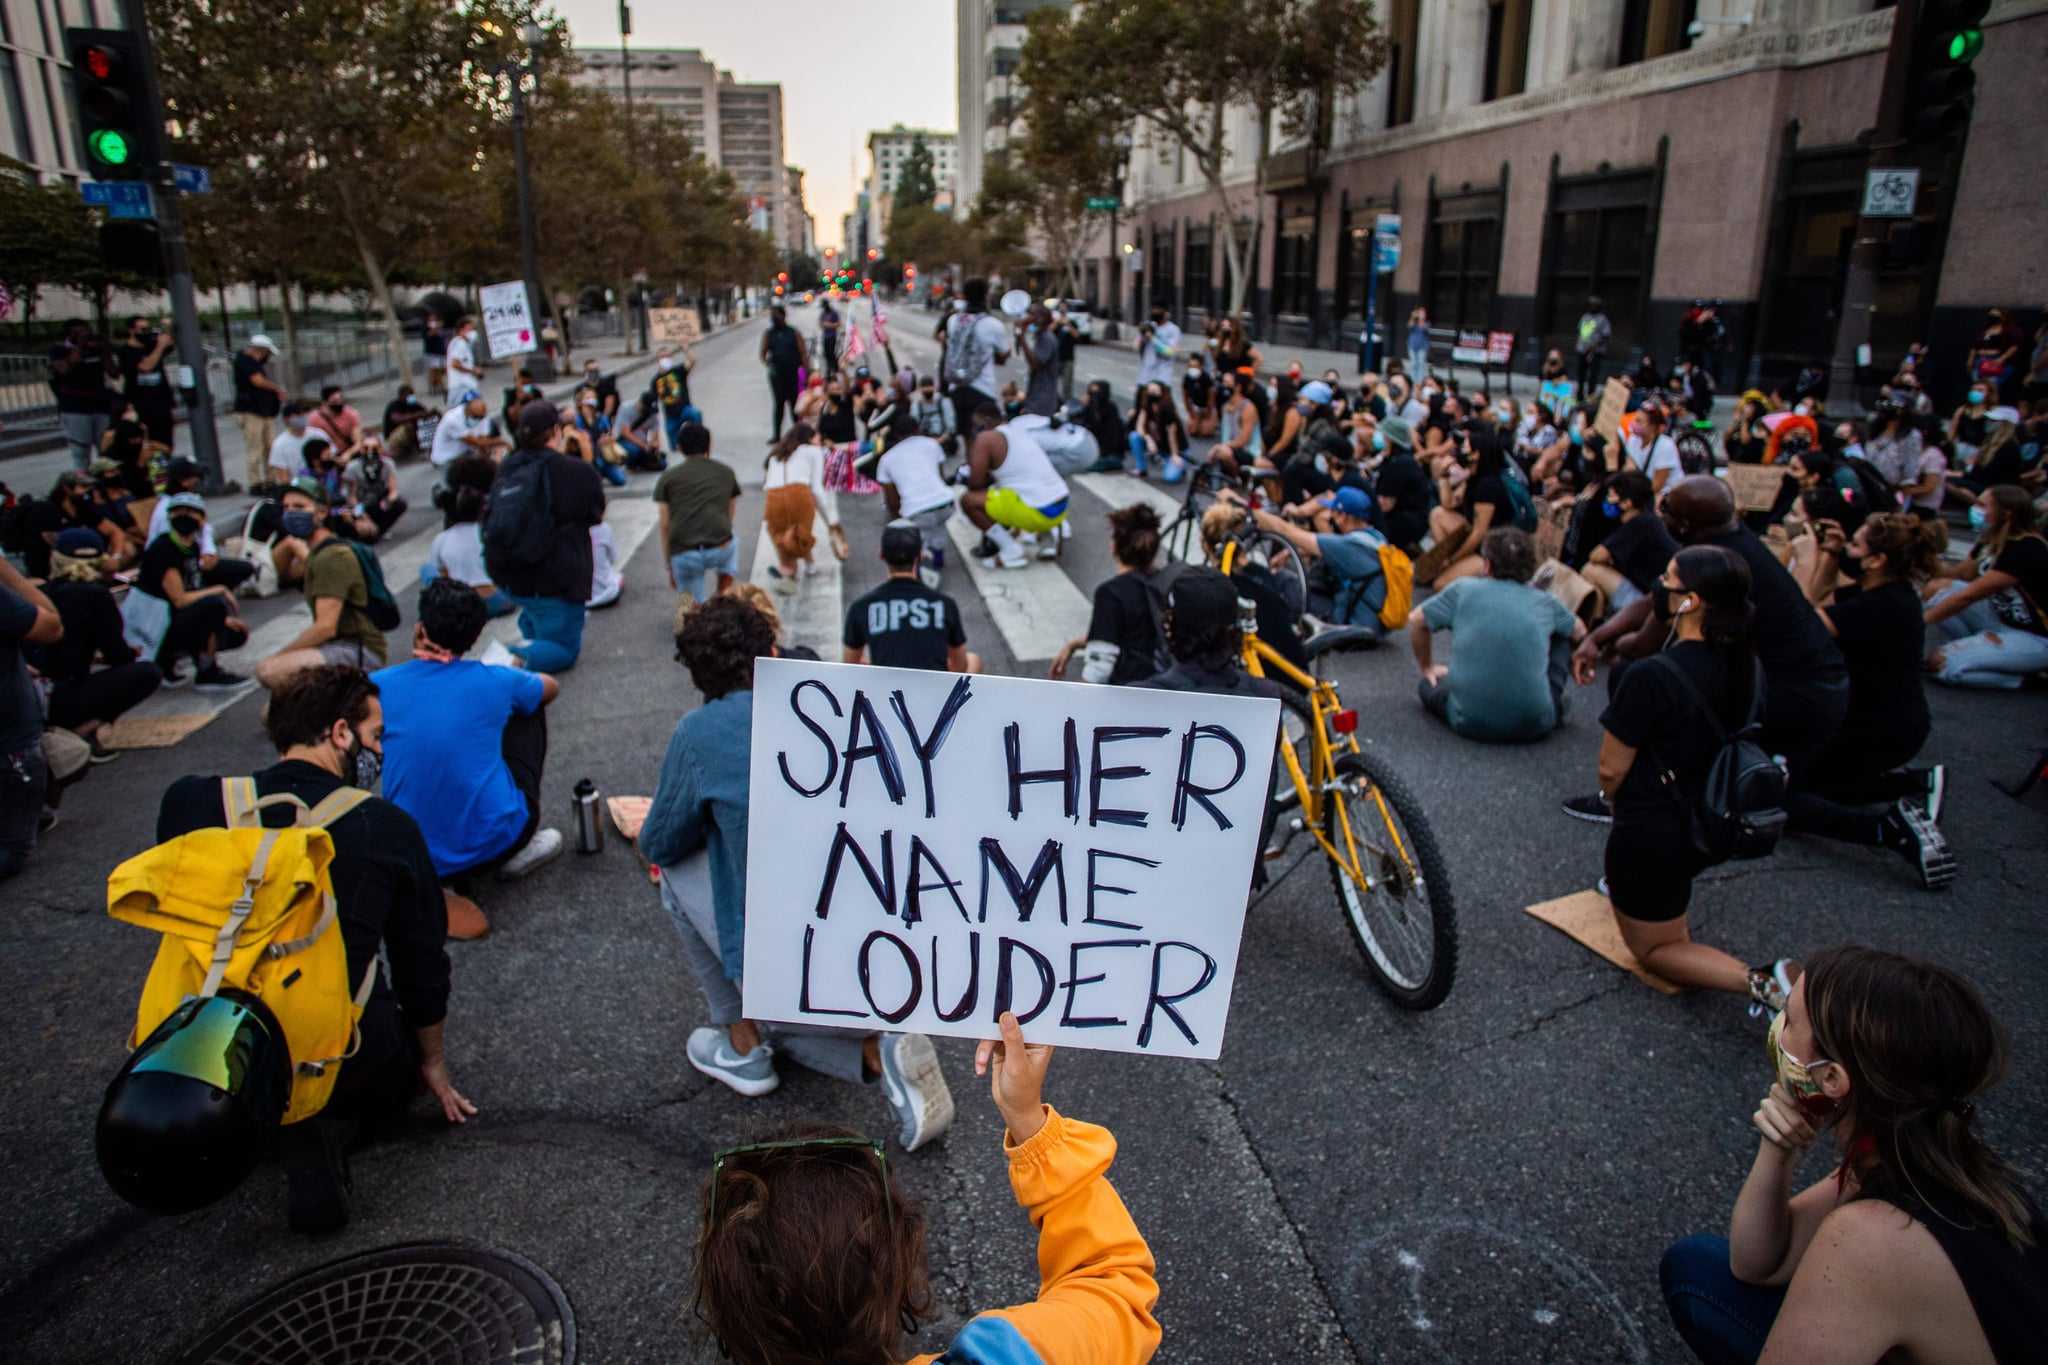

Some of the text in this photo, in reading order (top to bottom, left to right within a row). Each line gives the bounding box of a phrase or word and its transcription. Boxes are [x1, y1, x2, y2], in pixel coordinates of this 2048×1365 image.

[867, 598, 945, 635] DPS1
[777, 676, 1247, 831] SAY HER
[815, 821, 1163, 930] NAME
[798, 924, 1218, 1048] LOUDER
